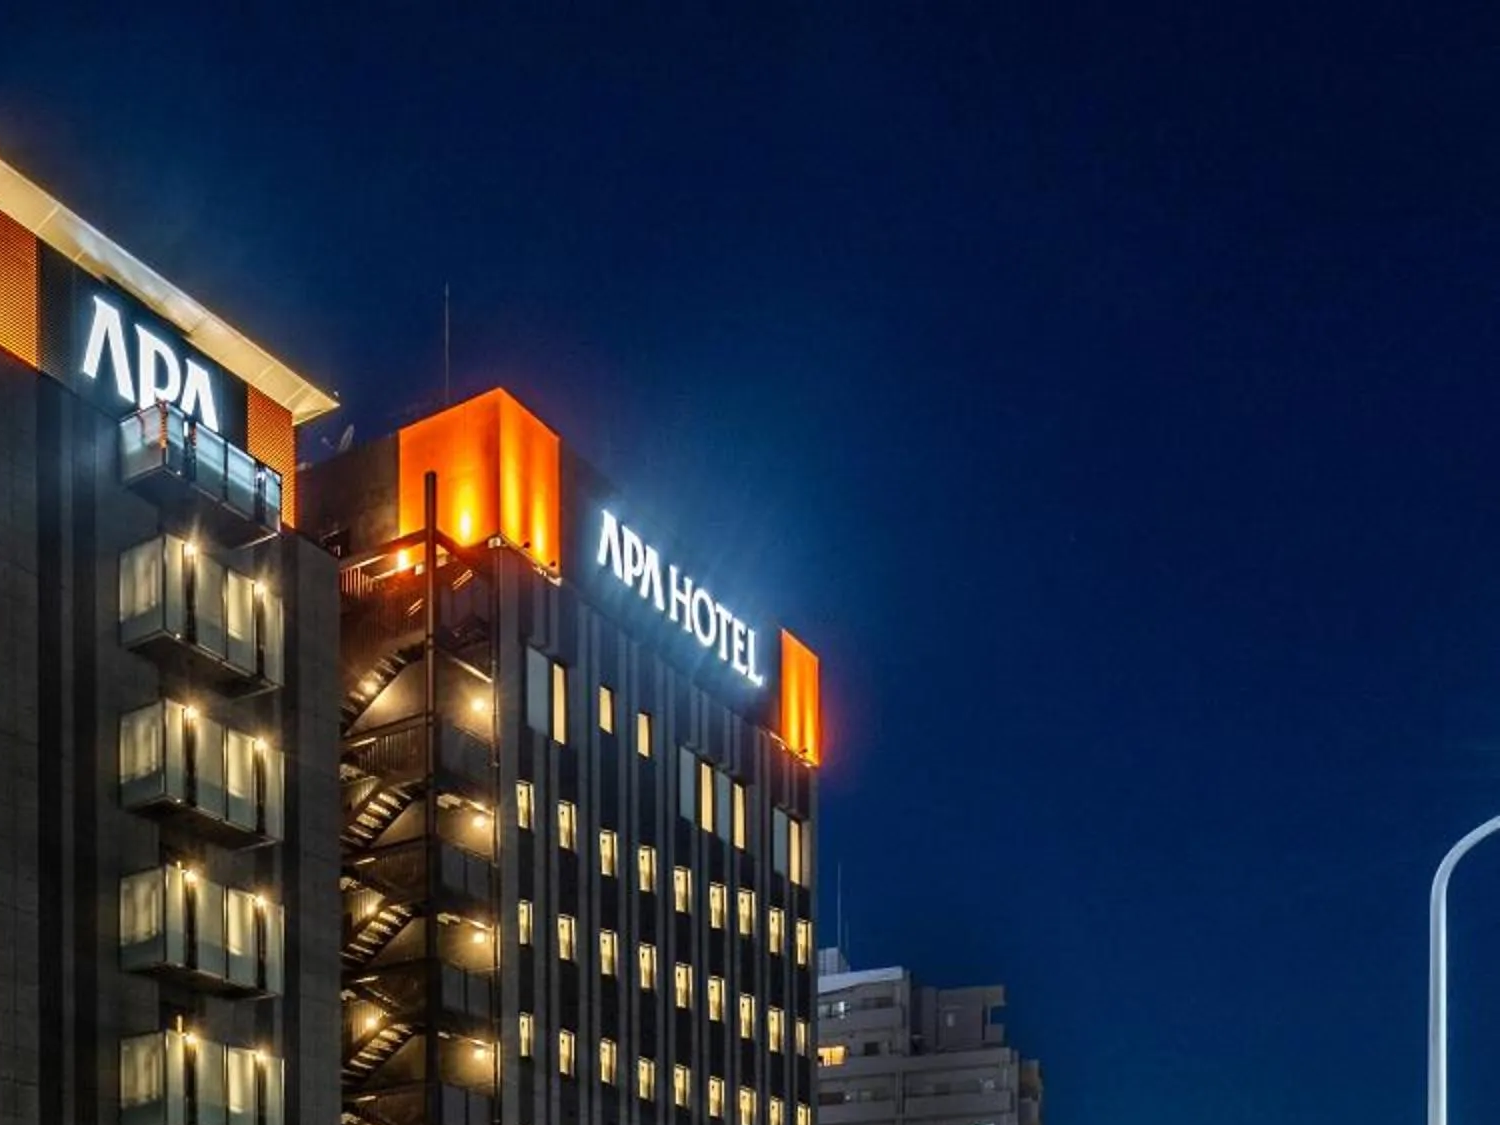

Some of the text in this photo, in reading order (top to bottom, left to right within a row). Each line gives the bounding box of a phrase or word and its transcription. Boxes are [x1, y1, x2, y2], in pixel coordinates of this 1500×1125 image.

[81, 295, 220, 434] APA
[596, 509, 765, 688] APA HOTEL
